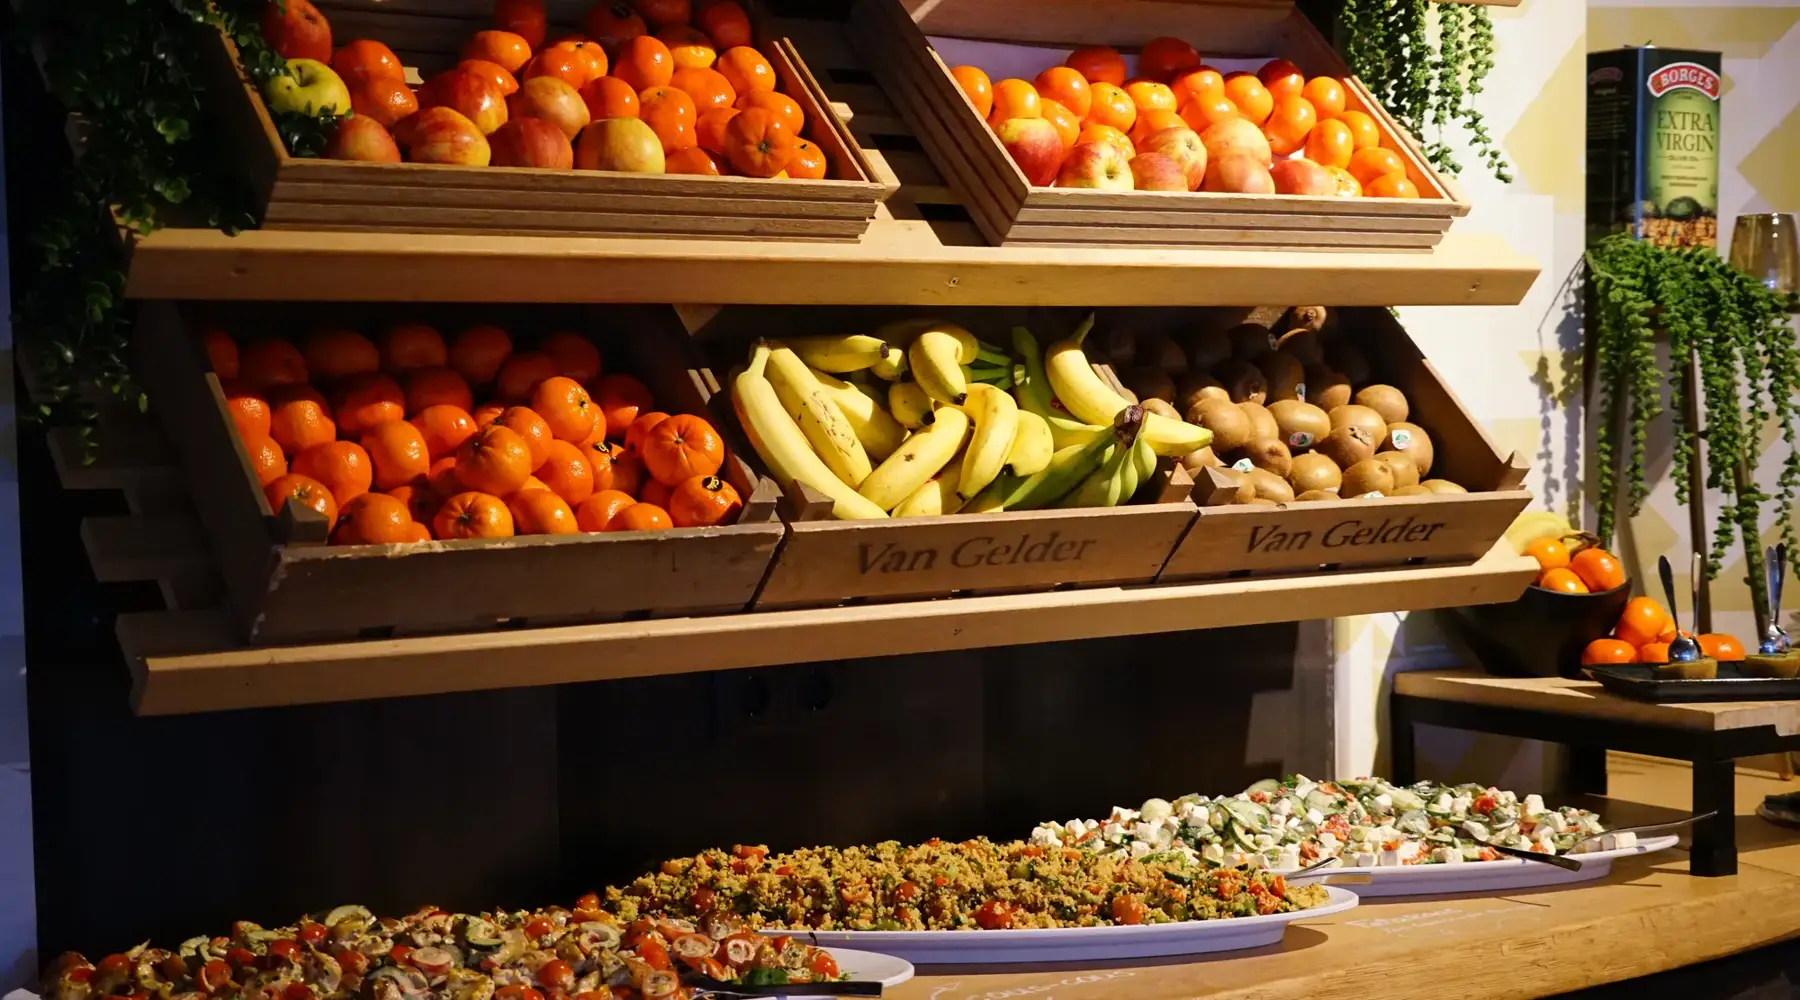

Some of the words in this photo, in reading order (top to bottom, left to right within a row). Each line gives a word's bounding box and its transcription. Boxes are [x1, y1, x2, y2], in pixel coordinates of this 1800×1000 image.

[1660, 68, 1713, 90] BORGES
[1656, 110, 1714, 131] EXTRA
[1656, 132, 1715, 152] VIRGIN
[1246, 523, 1313, 554] Van
[1320, 517, 1447, 548] Gelder
[857, 541, 939, 575] Van
[951, 530, 1098, 569] Gelder
